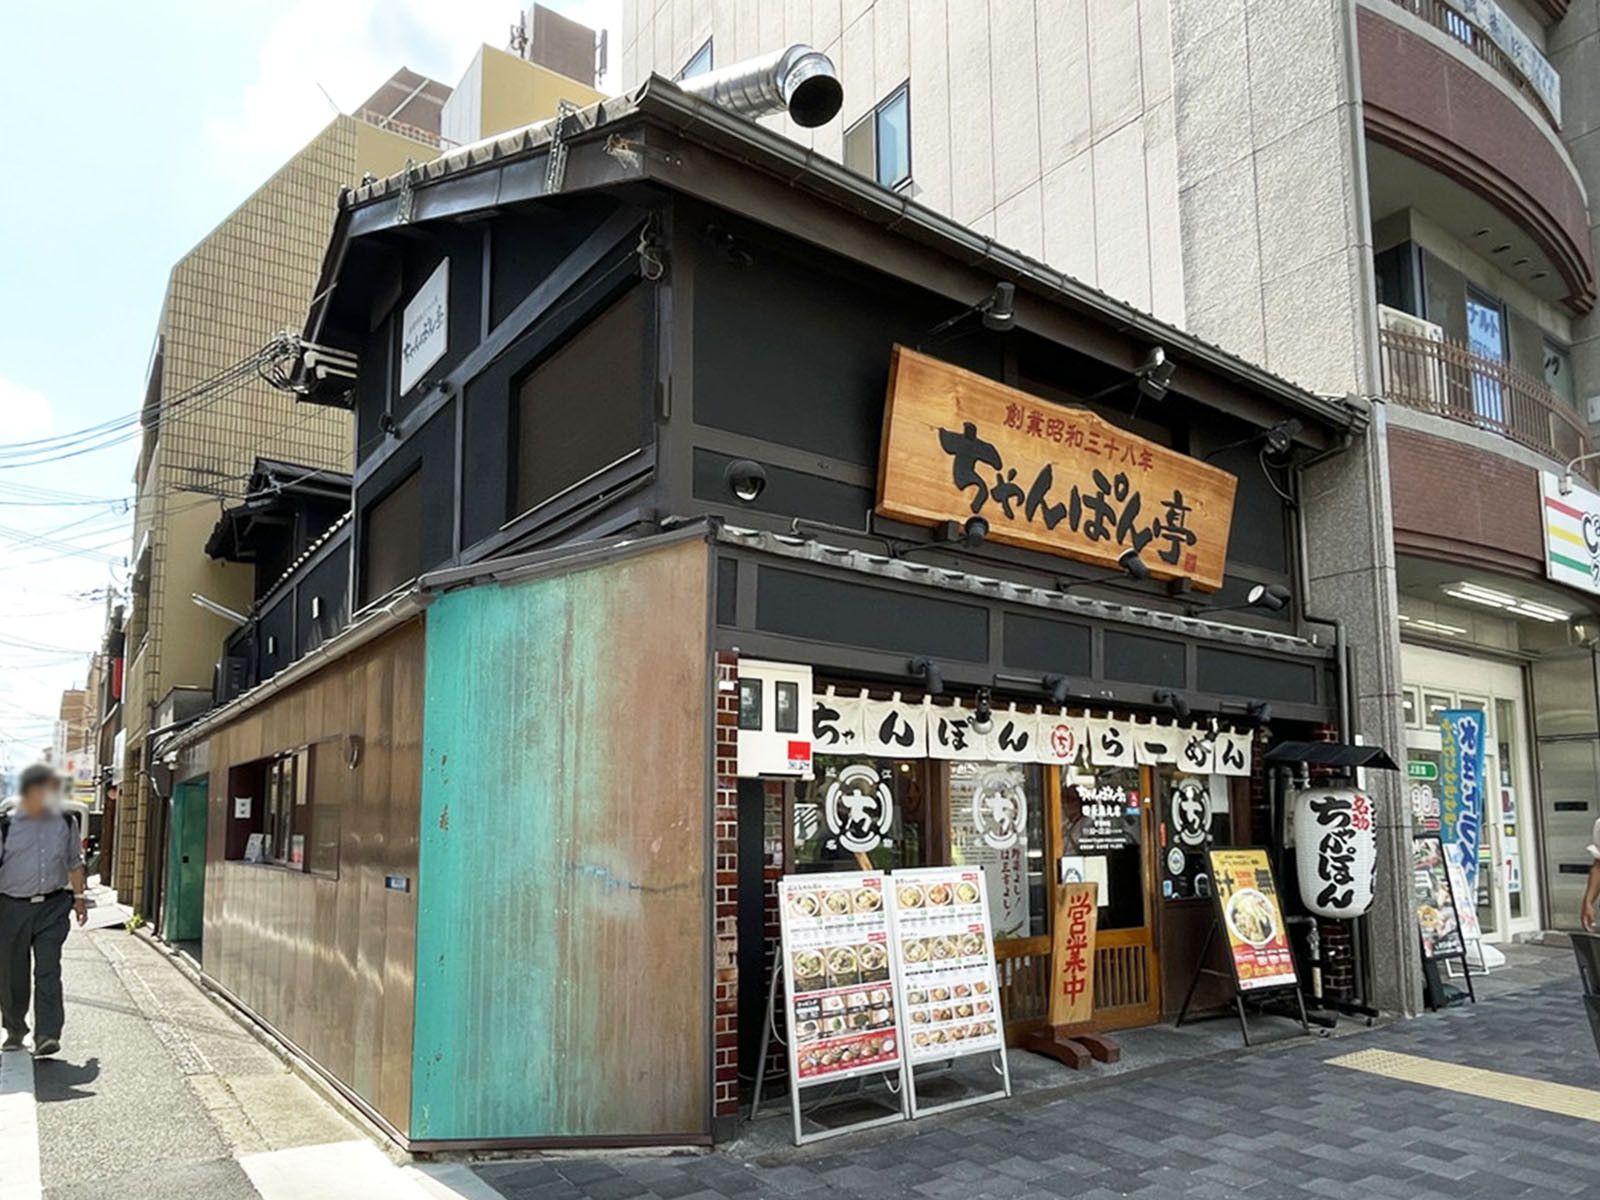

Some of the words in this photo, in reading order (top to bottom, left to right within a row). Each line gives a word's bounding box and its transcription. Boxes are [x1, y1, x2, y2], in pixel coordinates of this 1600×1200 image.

[938, 421, 1197, 565] ちゃんぽん亭
[1003, 402, 1153, 471] 創業昭和三十八年
[812, 701, 1029, 752] ちゃんぽん
[1101, 728, 1245, 770] らーめん
[1309, 796, 1356, 909] ちゃんぽん
[1063, 892, 1092, 1006] 営業中
